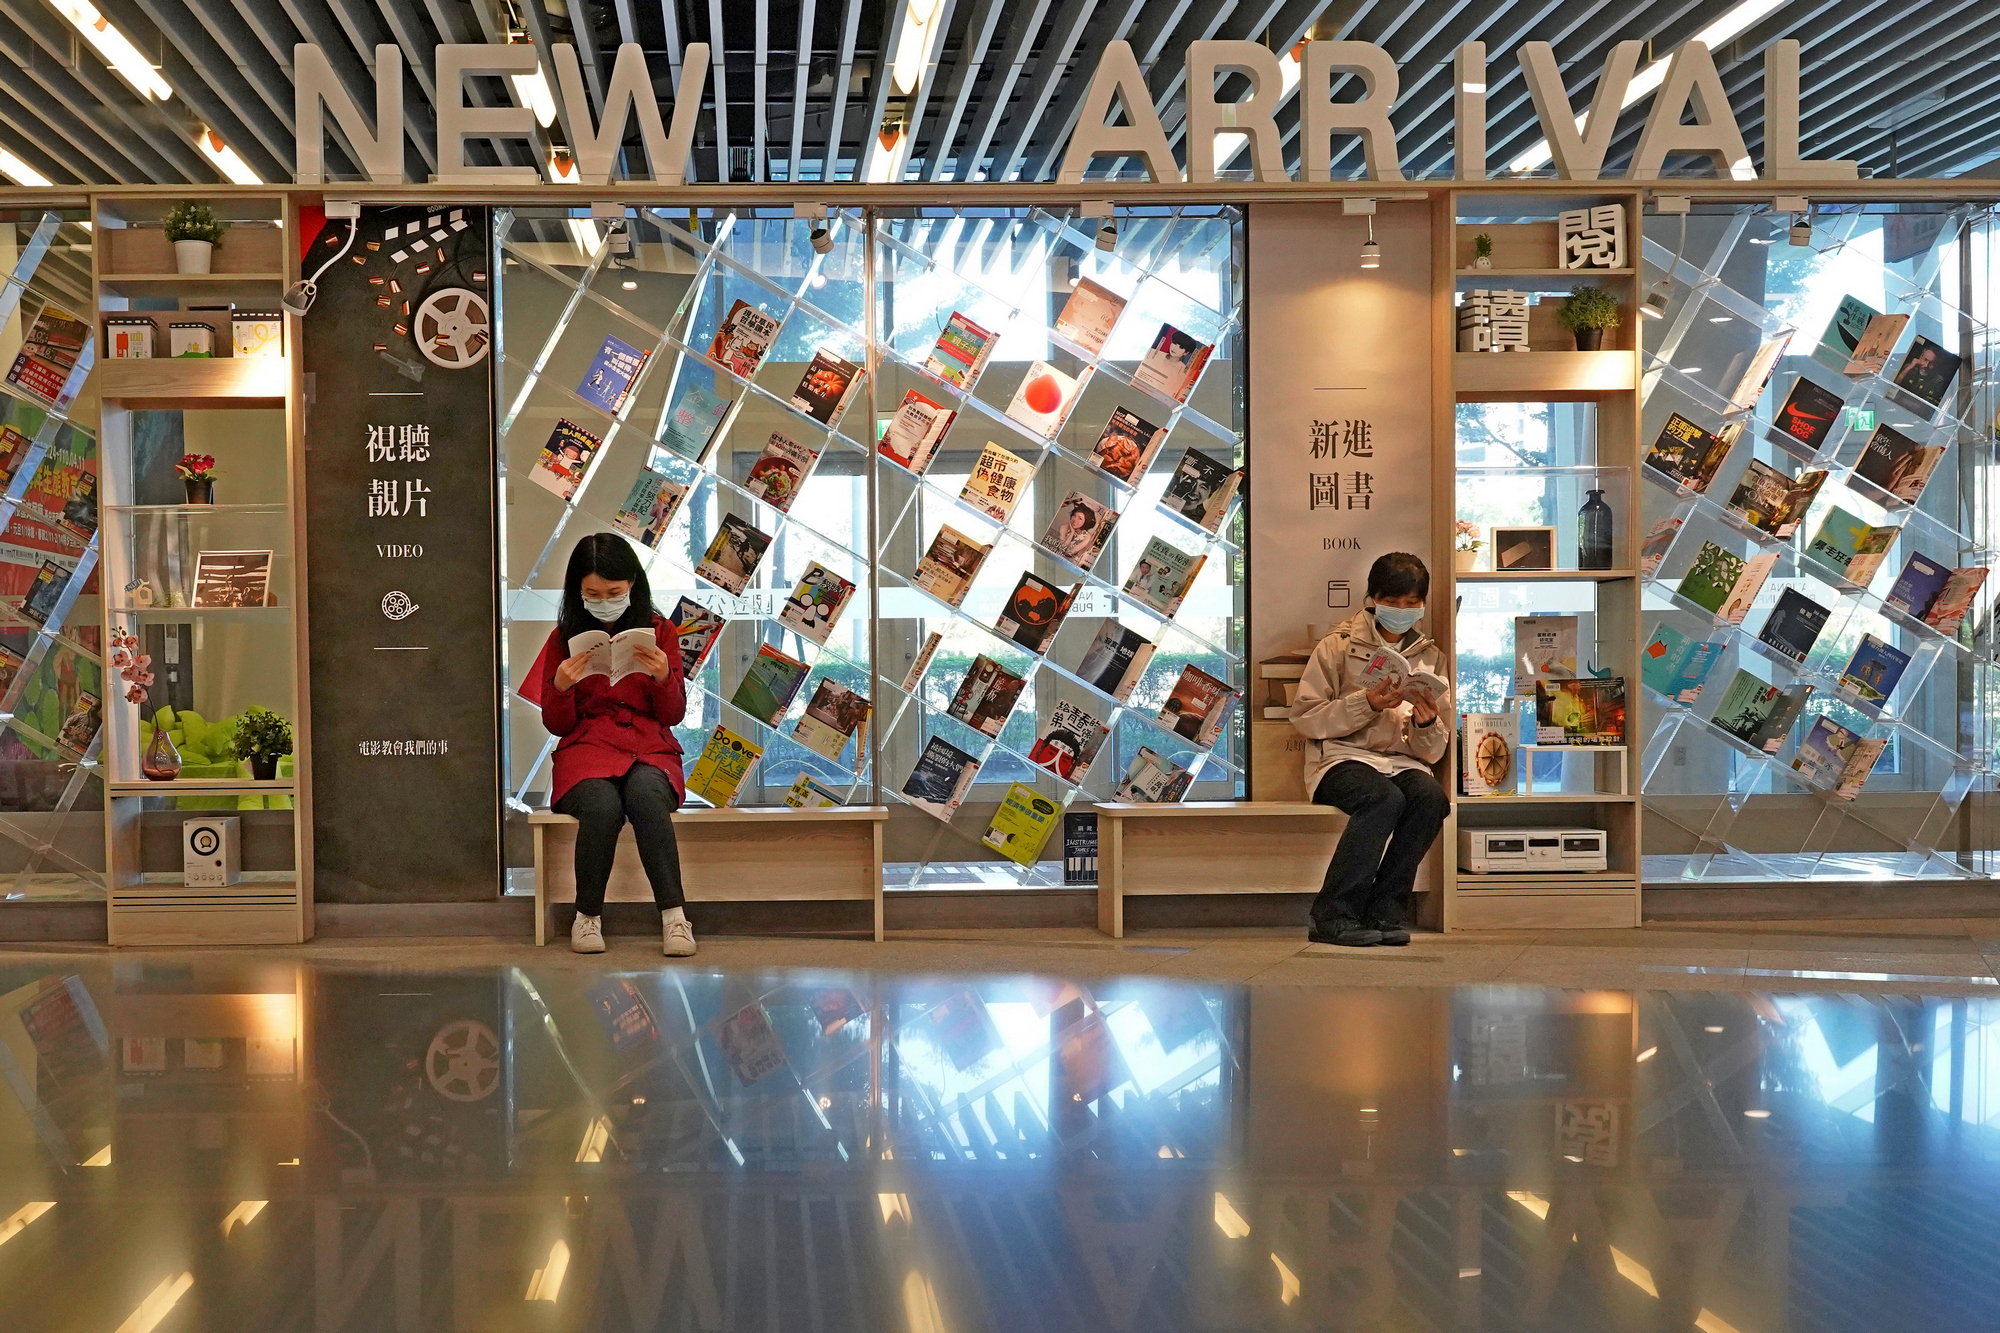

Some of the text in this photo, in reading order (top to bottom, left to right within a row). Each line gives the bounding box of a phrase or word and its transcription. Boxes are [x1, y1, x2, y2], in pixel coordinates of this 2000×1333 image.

[294, 39, 1859, 186] NEW ARRIVAL
[1558, 204, 1628, 269] 閱
[1460, 288, 1530, 352] 讀
[1309, 419, 1374, 460] 新進
[1790, 424, 1809, 438] DOG
[1791, 416, 1815, 433] SHOE
[365, 424, 431, 463] 視聽
[367, 479, 431, 518] 靚片
[1310, 471, 1374, 510] 圖書
[376, 544, 424, 558] VIDEO
[1323, 538, 1361, 550] BOOK
[358, 740, 448, 756] 電影教會我們的事
[712, 729, 731, 746] Do
[703, 747, 745, 776] 工作人生
